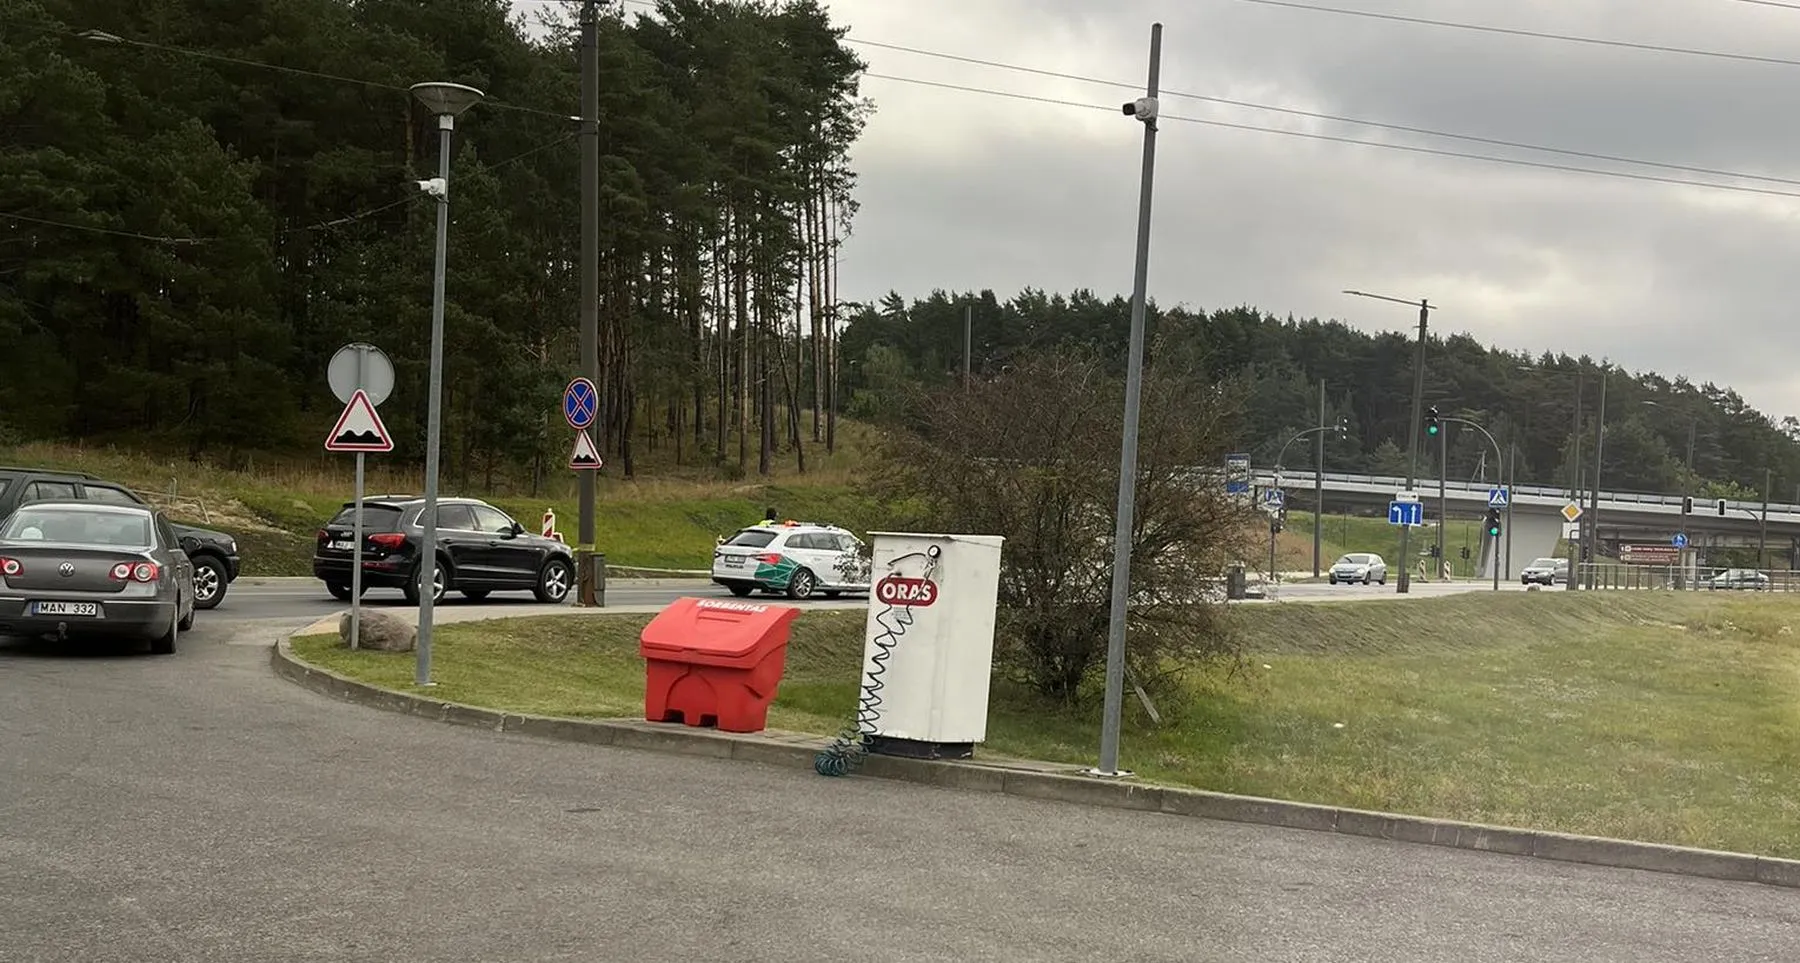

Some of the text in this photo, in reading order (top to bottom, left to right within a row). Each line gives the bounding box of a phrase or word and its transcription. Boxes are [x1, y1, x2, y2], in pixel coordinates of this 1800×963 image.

[882, 582, 932, 602] ORAS
[40, 602, 95, 614] MAN 332
